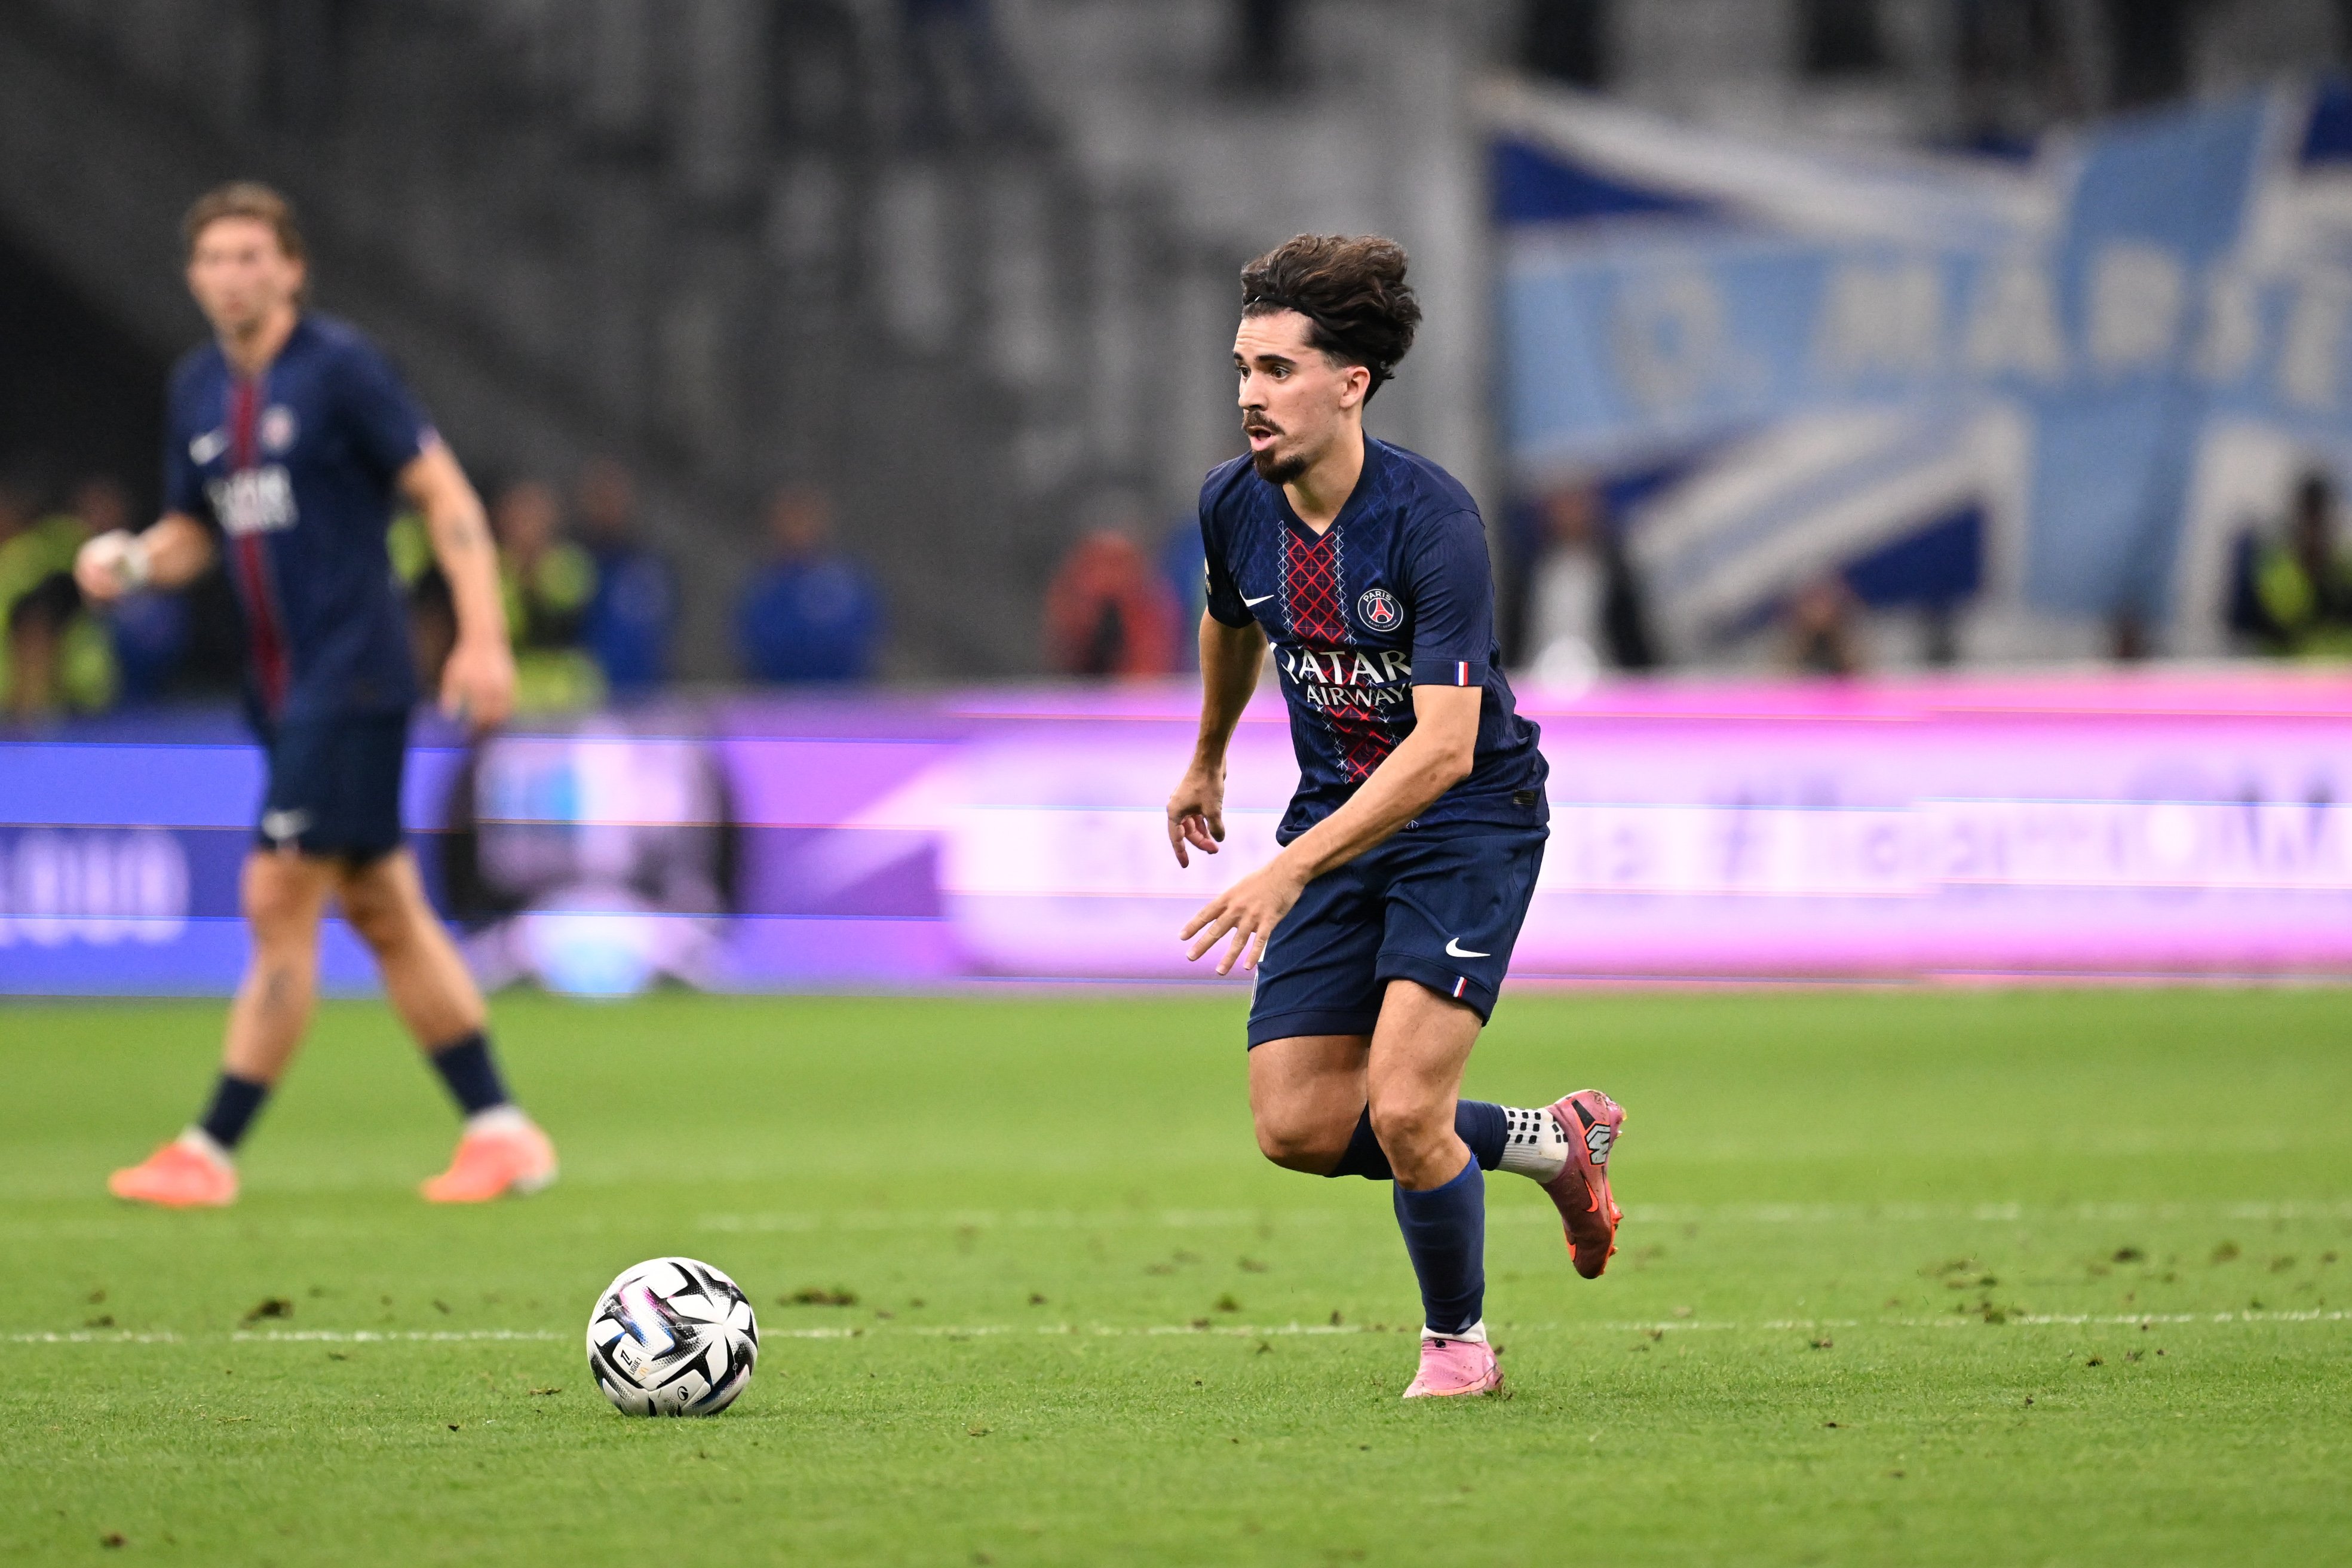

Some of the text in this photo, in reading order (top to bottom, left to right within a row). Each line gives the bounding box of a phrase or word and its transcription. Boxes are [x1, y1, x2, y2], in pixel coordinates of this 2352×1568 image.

[1363, 591, 1392, 603] PARIS
[1307, 681, 1413, 708] AIRWAY
[628, 1360, 640, 1376] LIGUE
